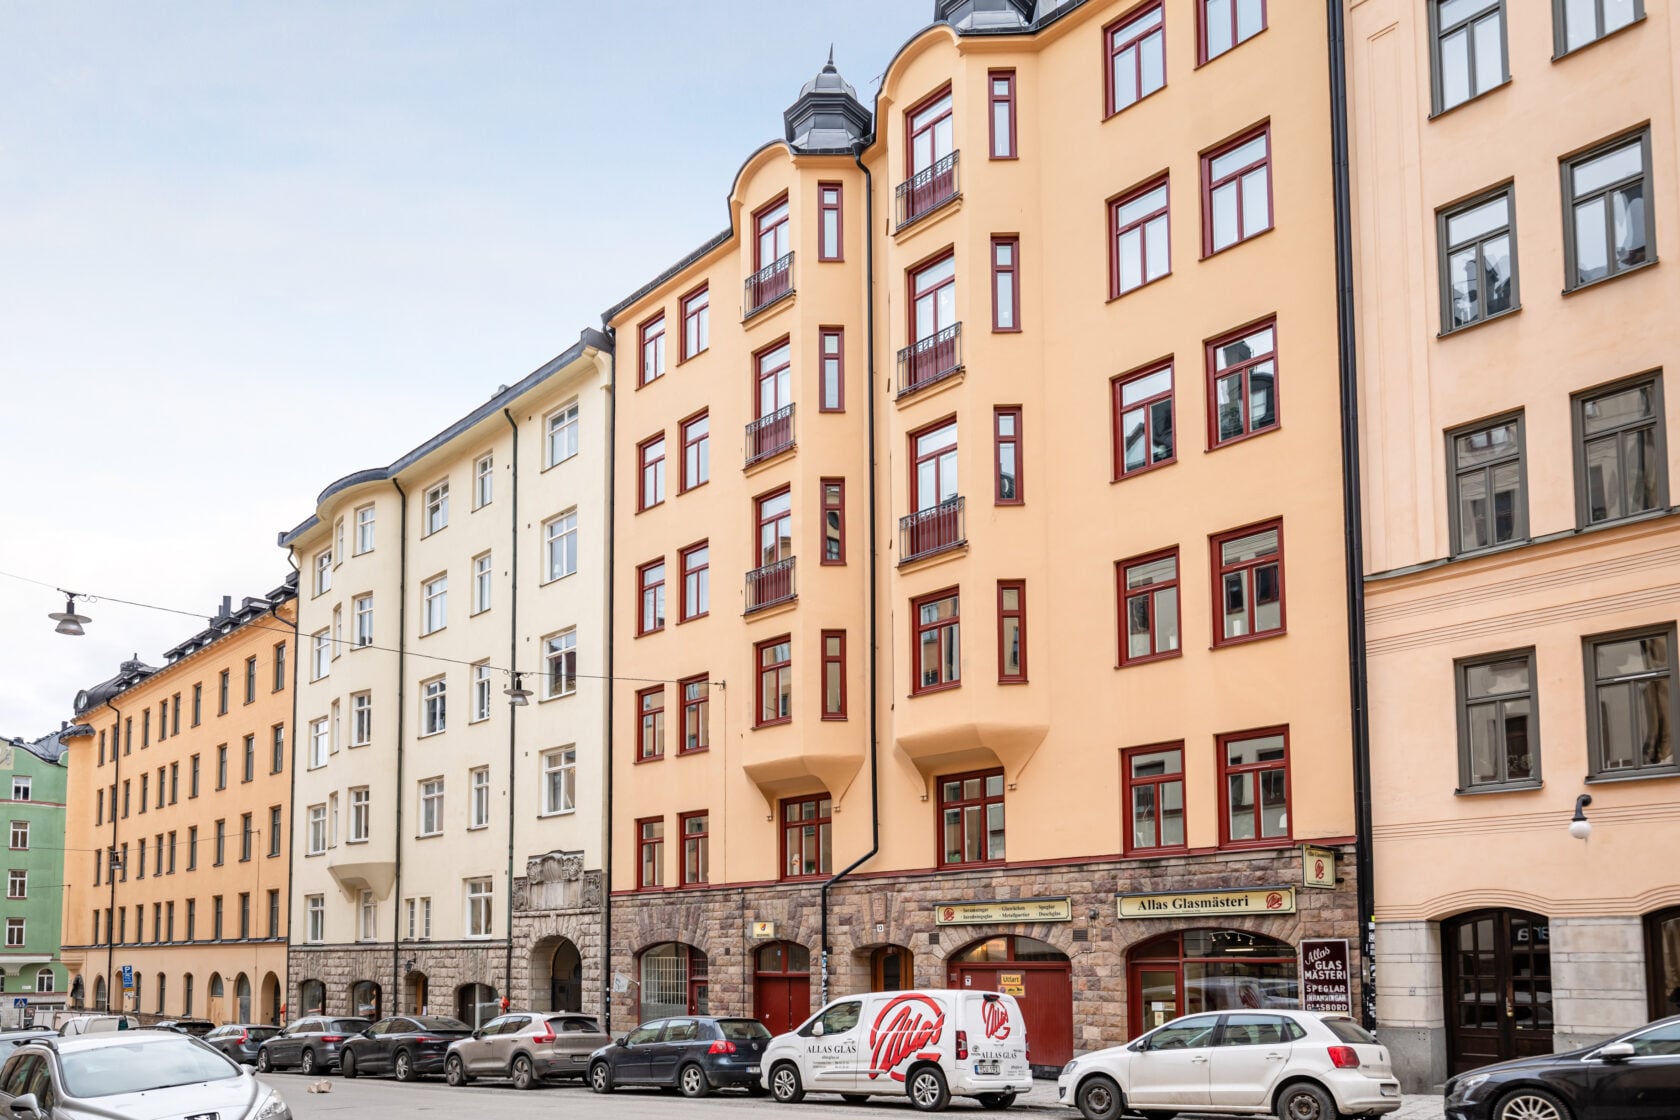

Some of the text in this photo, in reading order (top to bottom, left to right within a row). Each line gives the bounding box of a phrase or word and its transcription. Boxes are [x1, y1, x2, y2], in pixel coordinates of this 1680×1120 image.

[1138, 895, 1249, 911] Allas Glasmästeri
[1304, 946, 1331, 965] Allas
[1315, 960, 1343, 970] GLAS
[1304, 968, 1346, 980] MÄSTERI
[1306, 985, 1346, 993] SPEGLAR
[869, 1005, 945, 1080] Allas
[806, 1045, 856, 1054] ALLAS GLAS
[980, 1051, 1002, 1059] ALLAS
[1003, 1051, 1017, 1059] GLAS
